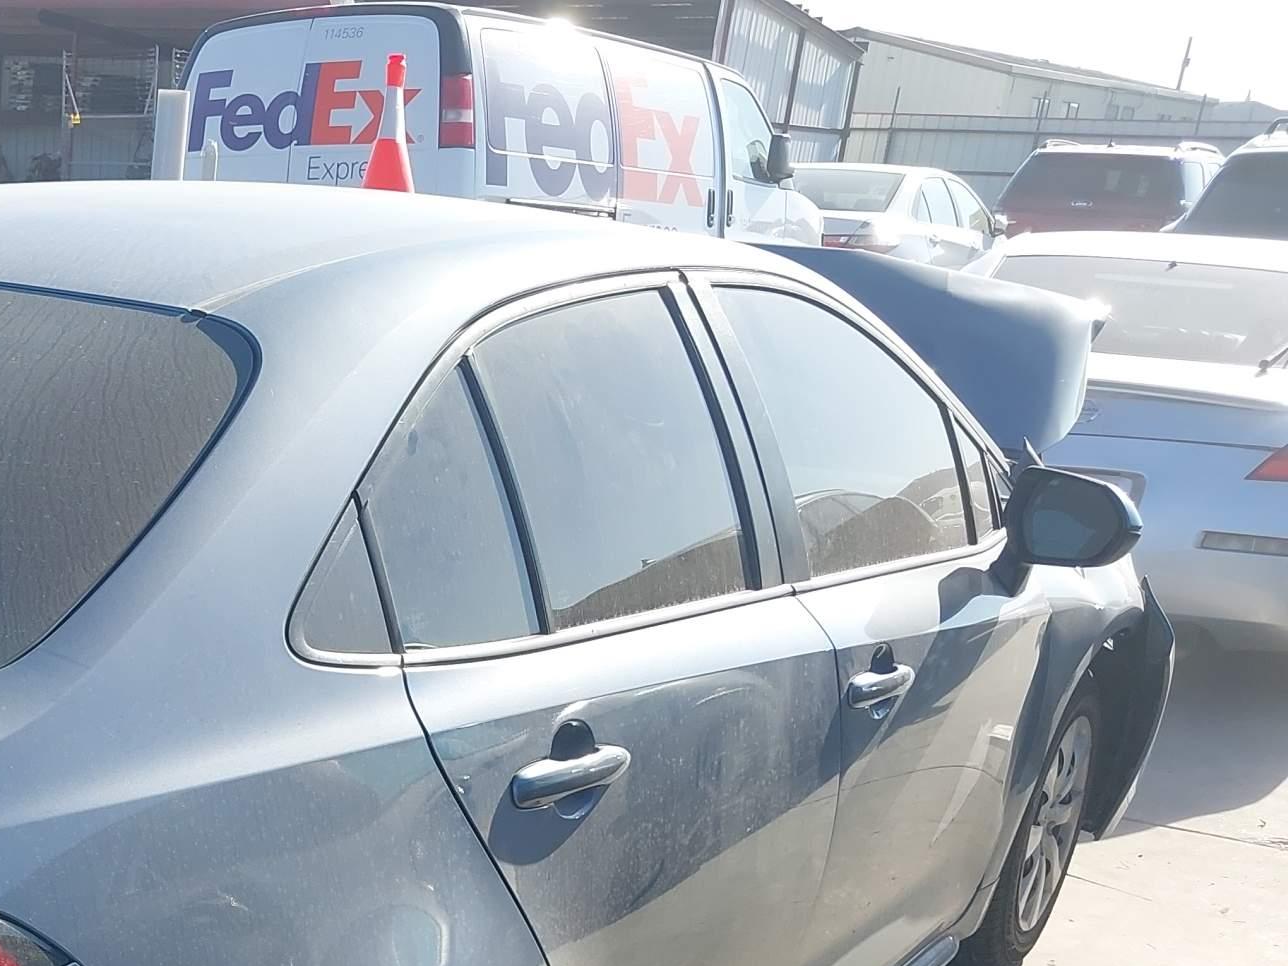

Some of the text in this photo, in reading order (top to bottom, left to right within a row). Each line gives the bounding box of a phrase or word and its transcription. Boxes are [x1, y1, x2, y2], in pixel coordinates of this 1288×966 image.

[324, 26, 365, 40] 114536
[187, 59, 422, 152] FedEx
[486, 64, 704, 208] FedEx
[306, 155, 368, 187] Expre
